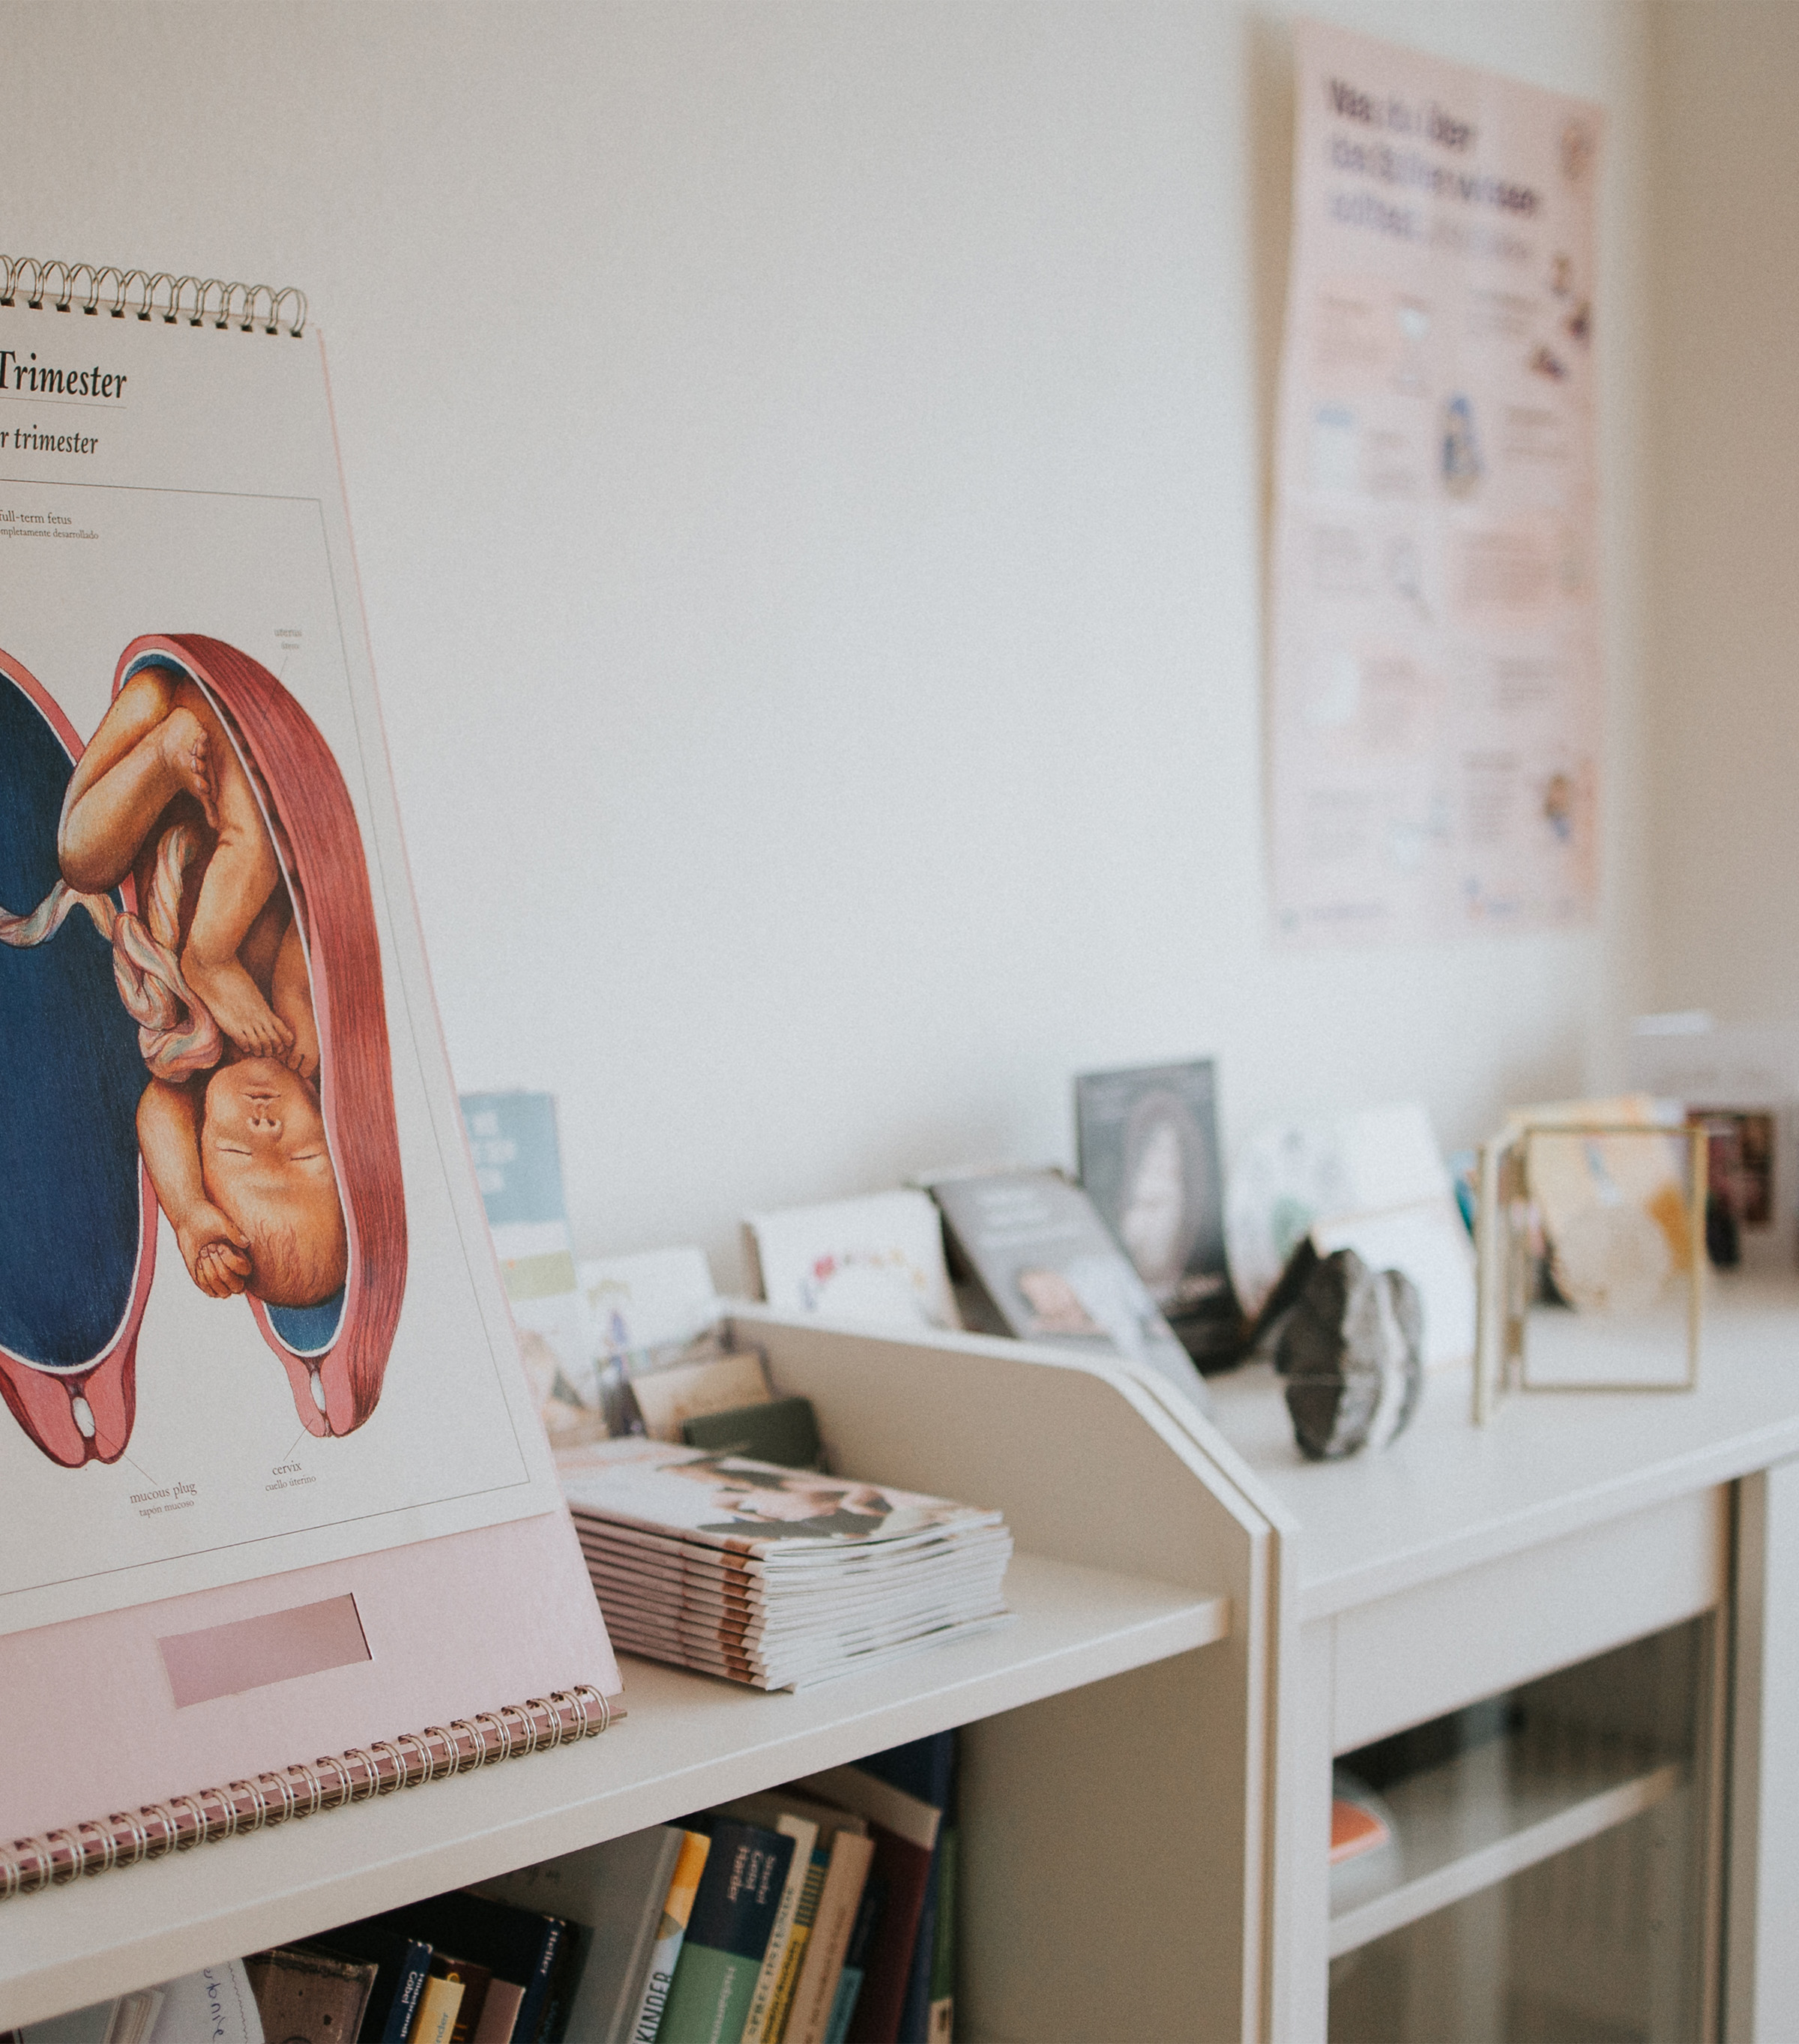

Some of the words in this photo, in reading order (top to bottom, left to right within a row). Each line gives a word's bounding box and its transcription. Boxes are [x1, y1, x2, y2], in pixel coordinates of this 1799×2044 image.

[0, 351, 127, 399] Trimester
[13, 423, 98, 454] trimester
[47, 512, 73, 525] fetus
[0, 527, 51, 538] mpletamente
[53, 528, 99, 540] desarrollado
[272, 1460, 303, 1476] cervix
[130, 1488, 171, 1504] mucous
[172, 1481, 198, 1500] plug
[265, 1480, 288, 1492] cuello
[164, 1500, 195, 1512] mucoso
